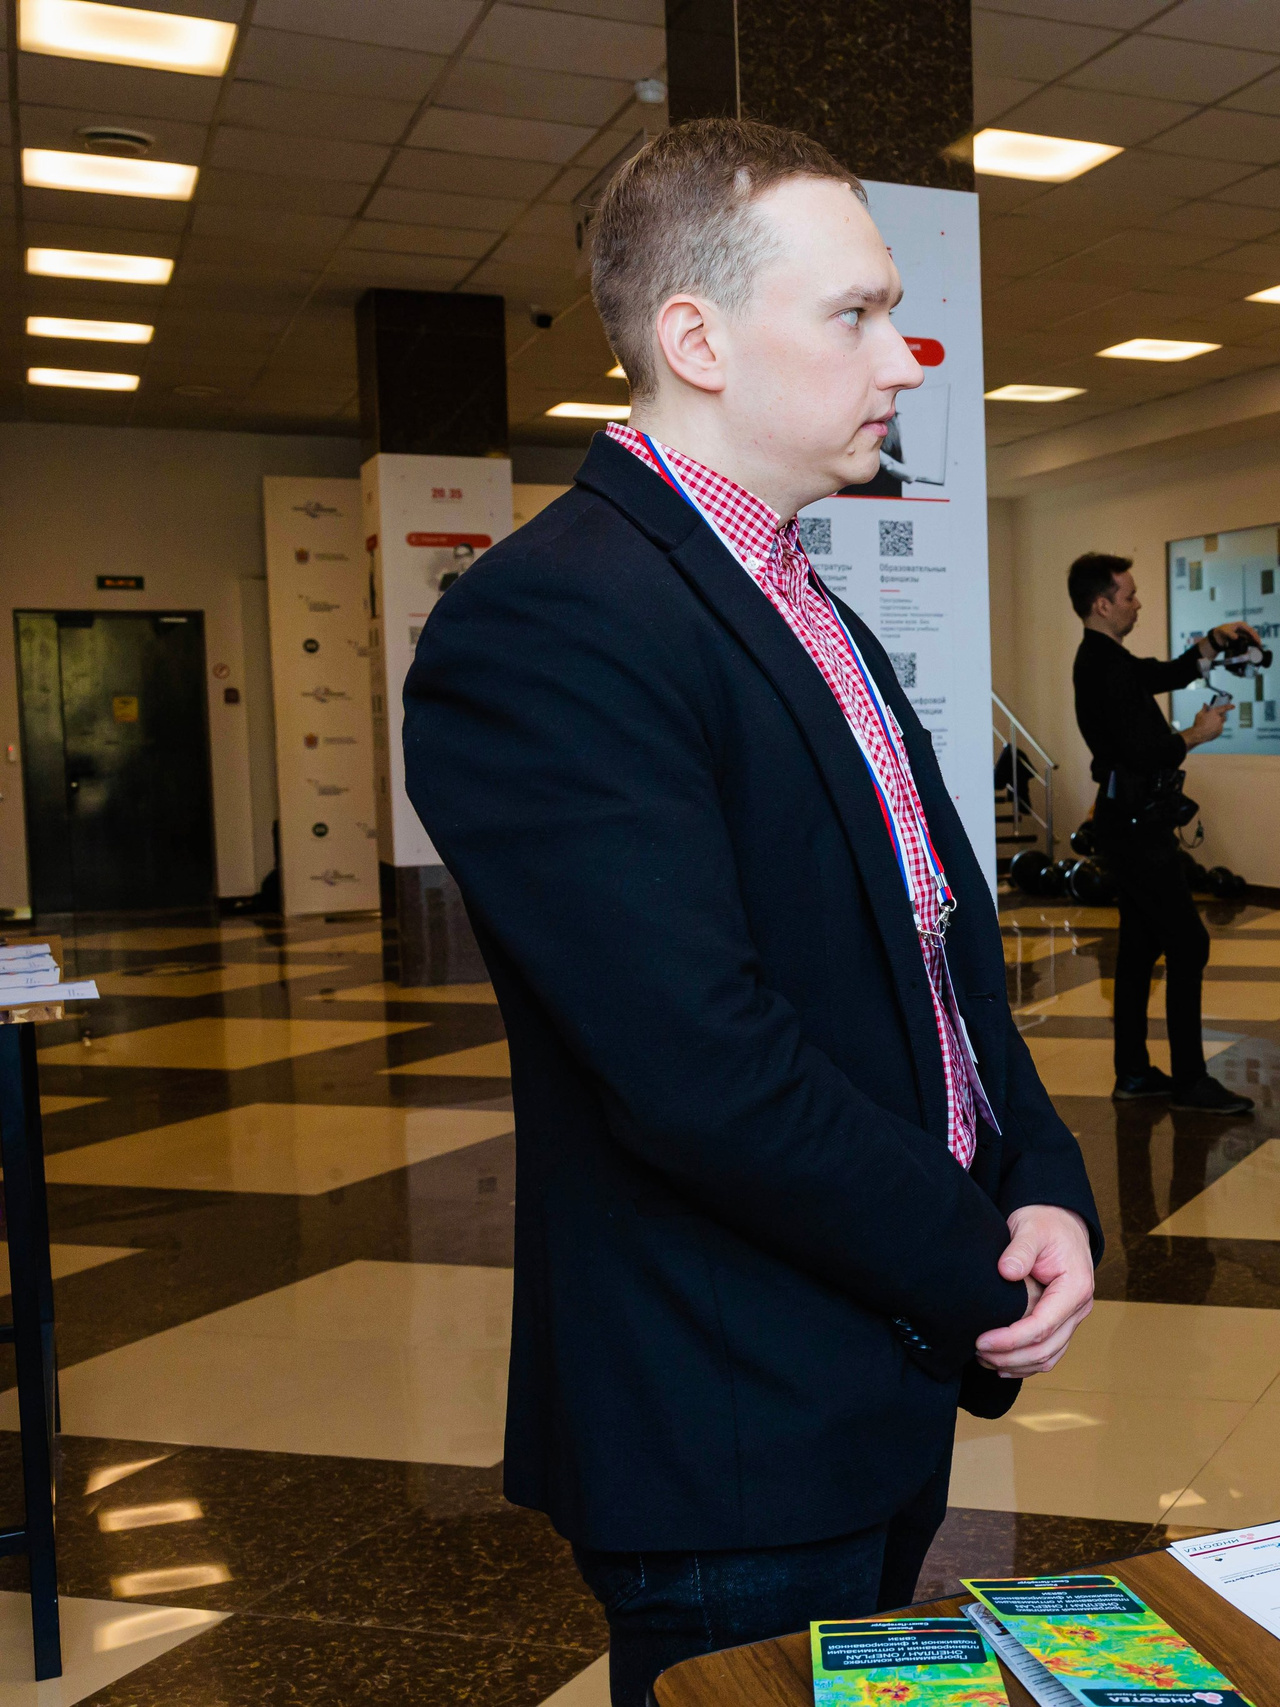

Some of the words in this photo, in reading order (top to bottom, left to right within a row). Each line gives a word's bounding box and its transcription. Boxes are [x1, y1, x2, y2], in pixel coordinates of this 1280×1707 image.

[880, 564, 946, 572] Образовательные
[880, 575, 919, 583] франшизы
[1184, 1539, 1239, 1553] ИНФОТЕЛ
[829, 1641, 909, 1649] фиксированной
[827, 1647, 895, 1655] оптимизации
[846, 1652, 899, 1660] ONEPLAN
[895, 1654, 967, 1663] Программный
